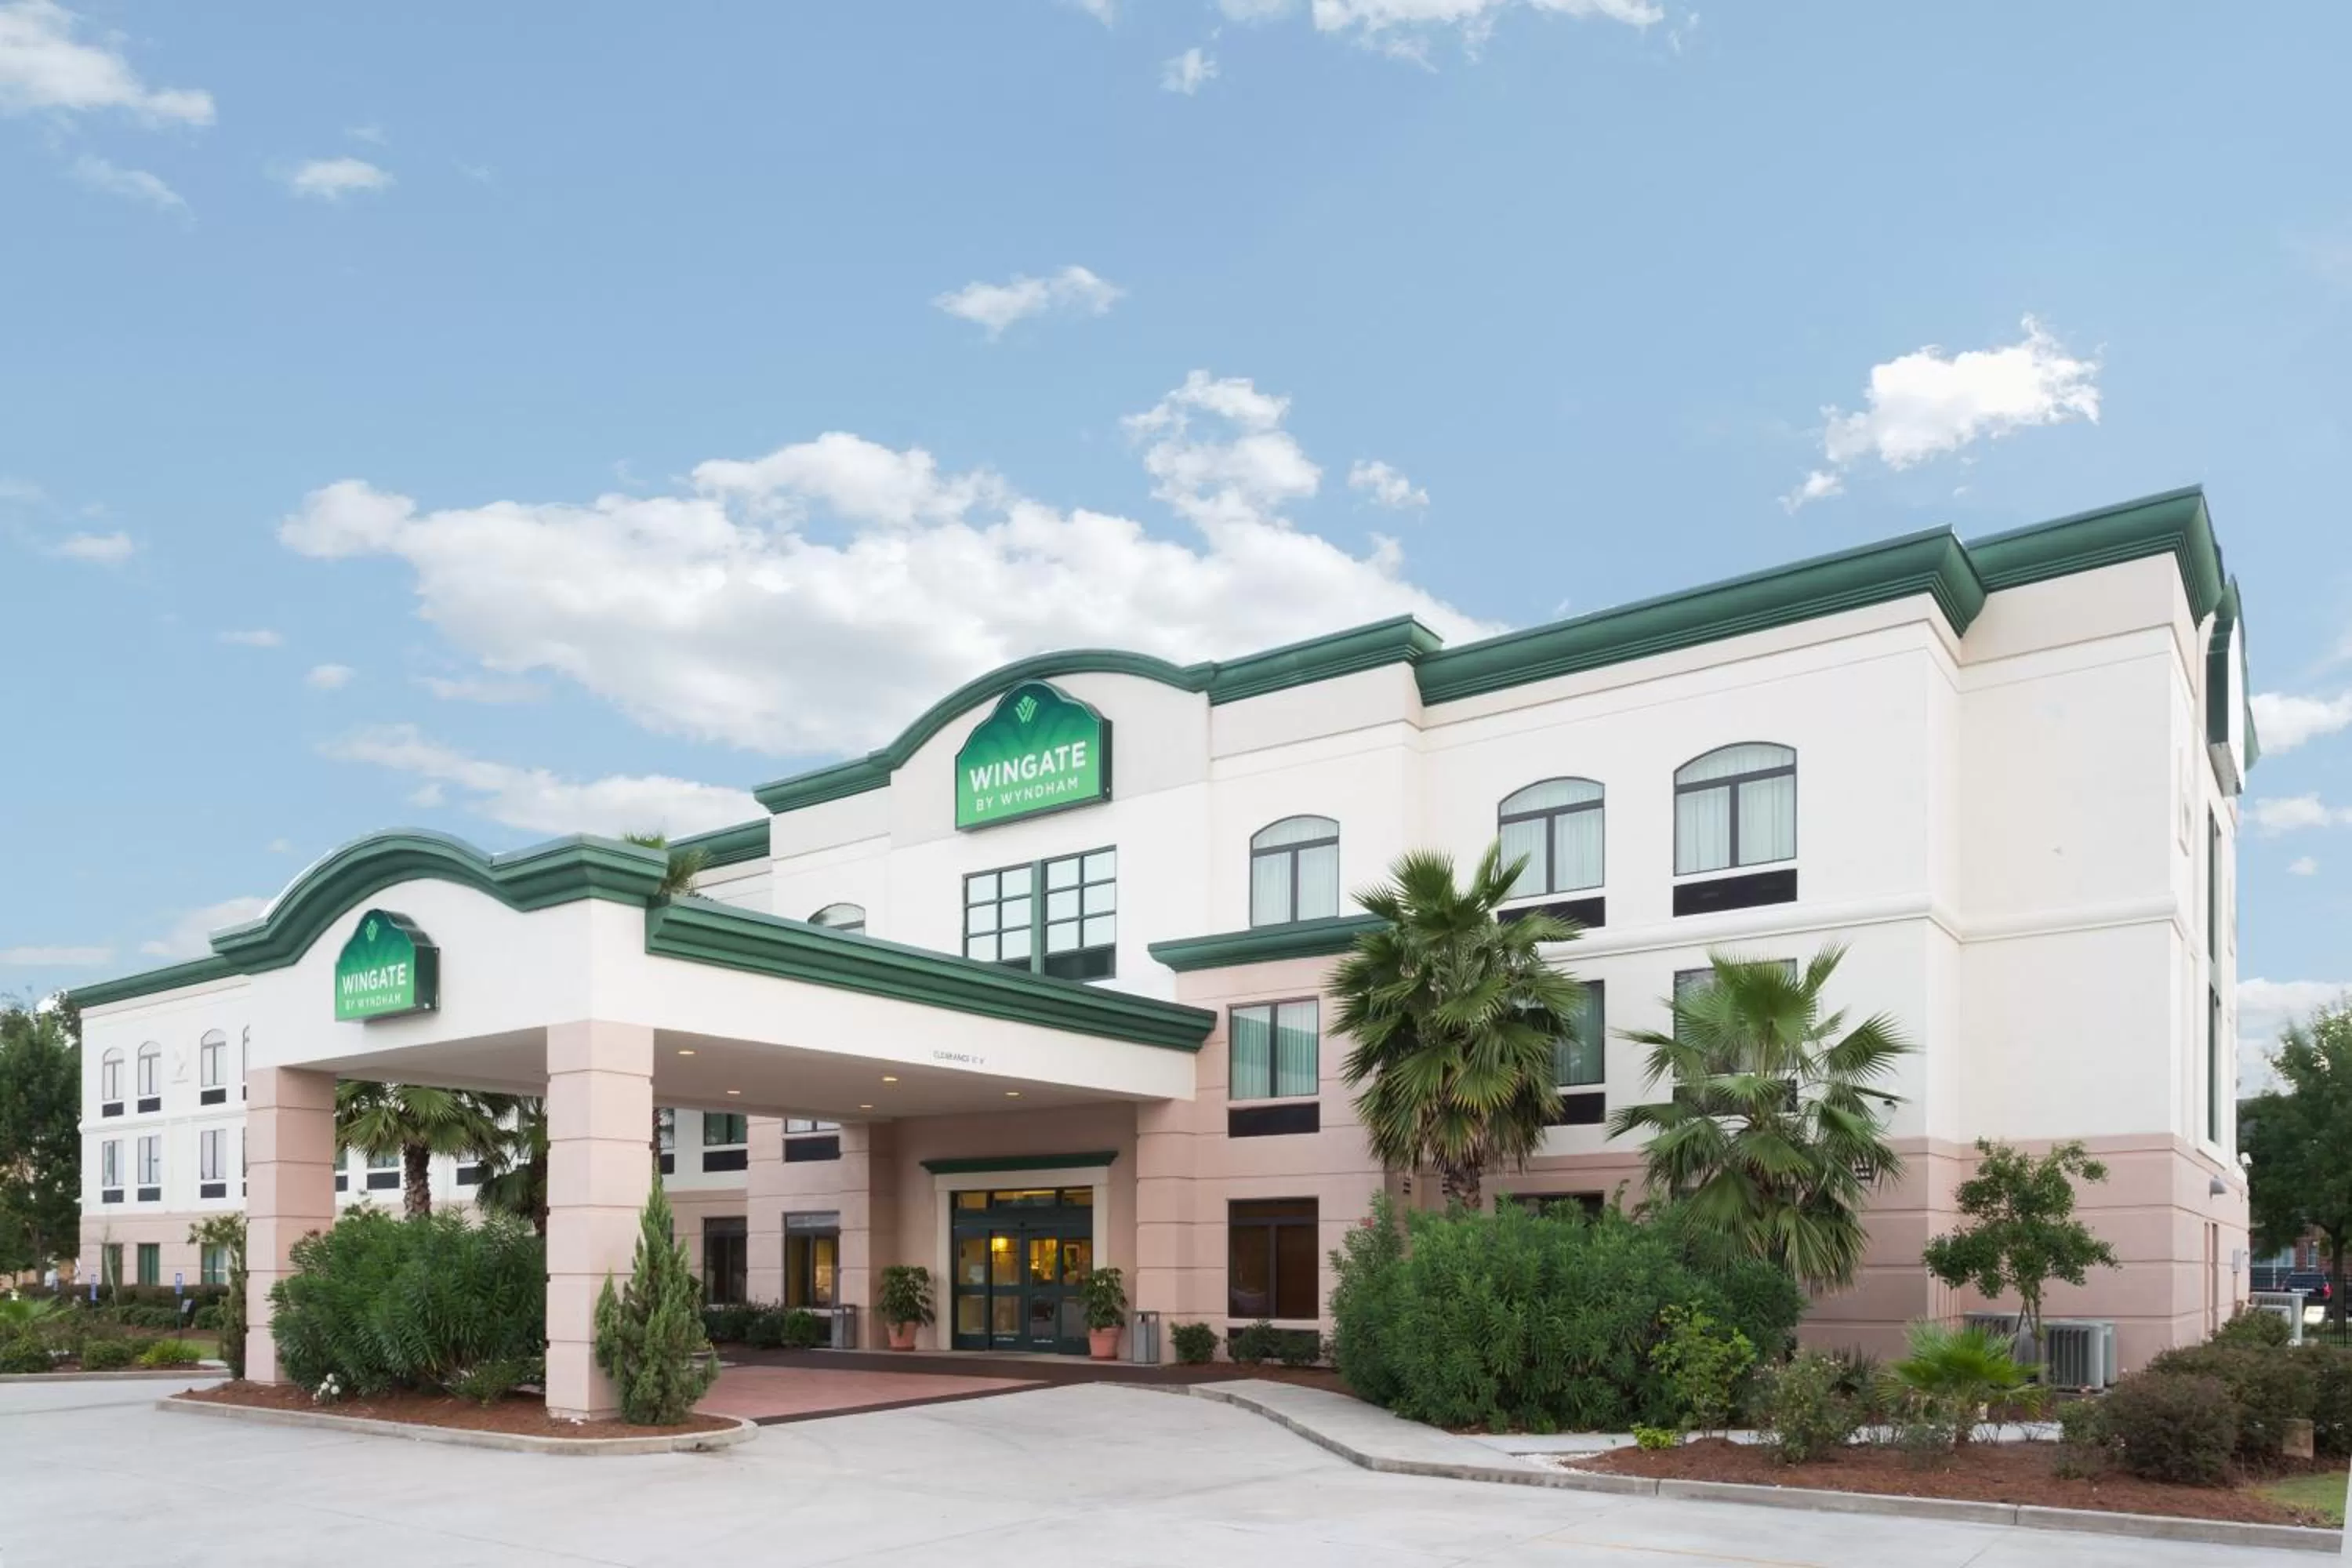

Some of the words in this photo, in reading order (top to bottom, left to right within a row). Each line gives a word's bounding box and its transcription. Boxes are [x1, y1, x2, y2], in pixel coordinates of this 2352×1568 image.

[969, 740, 1087, 793] WINGATE
[976, 796, 993, 813] BY
[1001, 776, 1078, 805] WYNDHAM
[342, 963, 407, 996] WINGATE
[345, 999, 354, 1011] BY
[358, 993, 401, 1008] WYNDHAM
